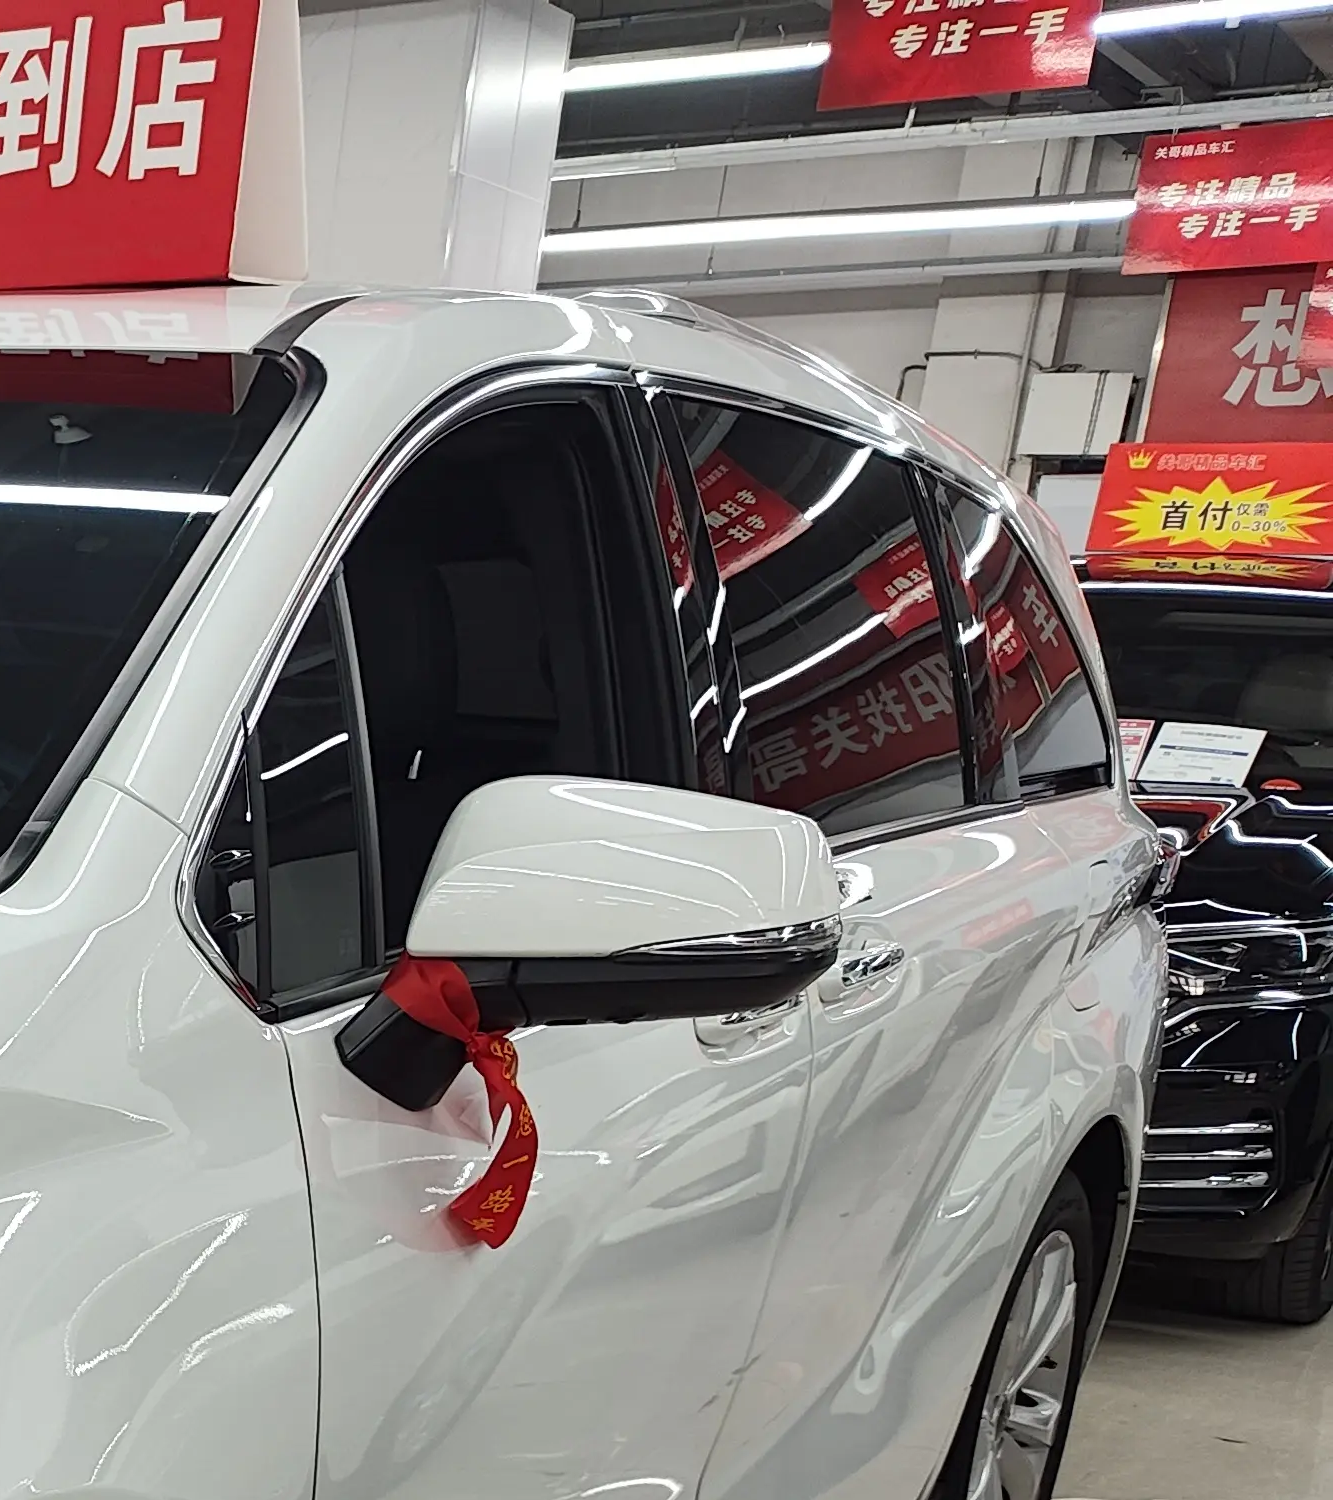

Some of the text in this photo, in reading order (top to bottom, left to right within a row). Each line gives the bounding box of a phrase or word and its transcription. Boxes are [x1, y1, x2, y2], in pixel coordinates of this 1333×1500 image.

[889, 7, 1070, 59] 专注一手
[1154, 140, 1236, 160] 关哥精品车汇
[1158, 172, 1298, 208] 专注精品
[1178, 203, 1321, 239] 专注一手
[1156, 453, 1268, 471] 关哥精品车汇
[1160, 500, 1270, 531] 首付 仅需
